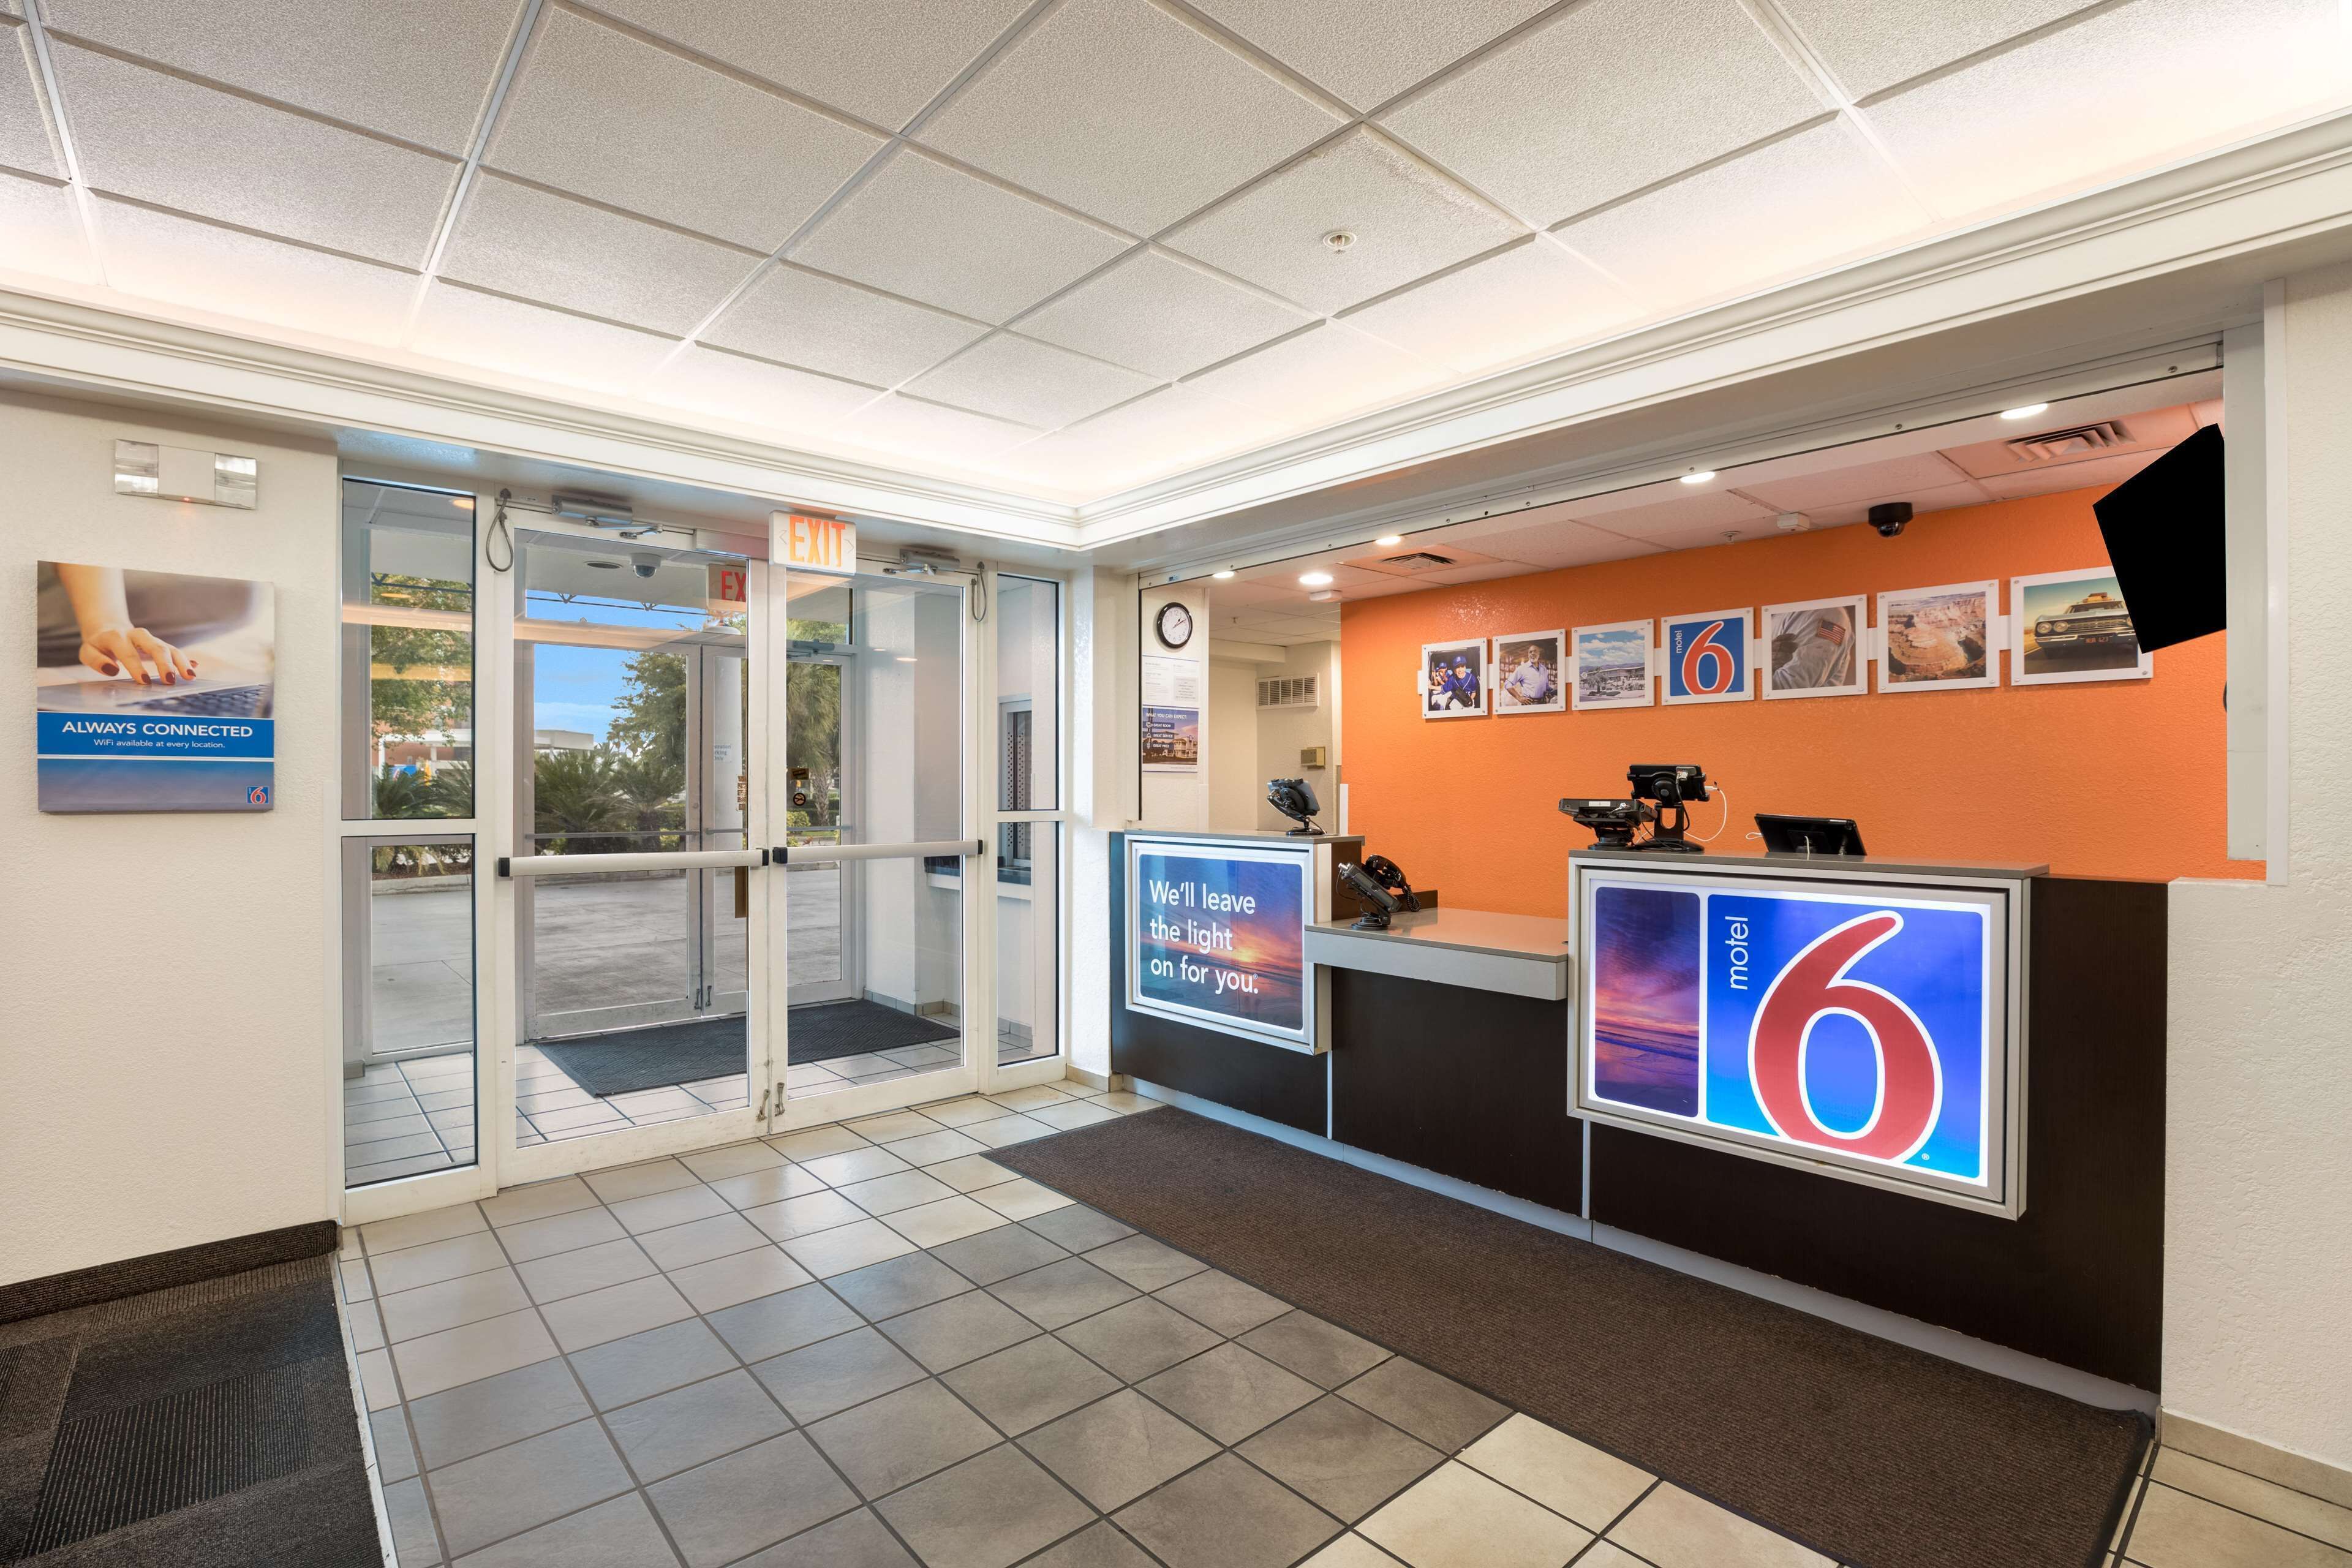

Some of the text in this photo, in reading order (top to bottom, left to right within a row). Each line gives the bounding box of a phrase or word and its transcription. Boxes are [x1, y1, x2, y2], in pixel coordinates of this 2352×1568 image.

[789, 516, 846, 568] EXIT
[721, 570, 746, 603] EX
[1681, 620, 1735, 696] 6
[62, 721, 253, 737] ALWAYS CONNECTED
[251, 785, 266, 804] 6
[1202, 883, 1256, 914] leave
[1150, 915, 1233, 954] the light
[1151, 959, 1173, 978] on
[1180, 956, 1208, 984] for
[1725, 916, 1749, 990] motel
[1747, 910, 1943, 1164] 6
